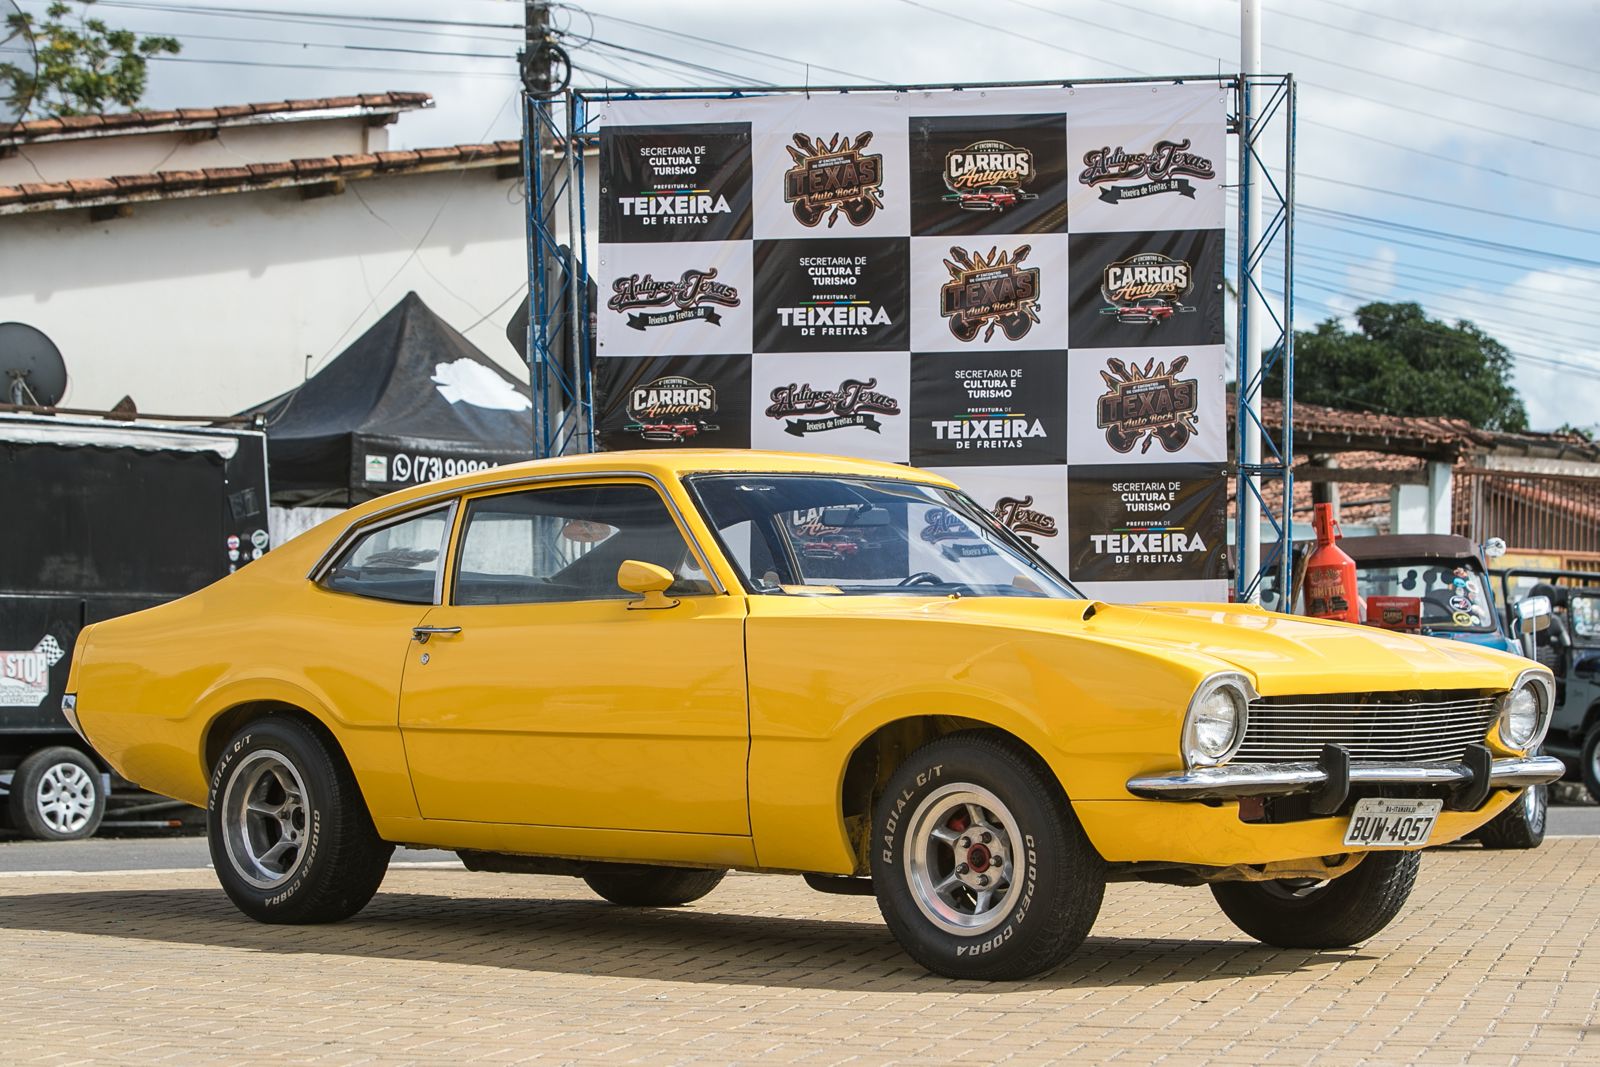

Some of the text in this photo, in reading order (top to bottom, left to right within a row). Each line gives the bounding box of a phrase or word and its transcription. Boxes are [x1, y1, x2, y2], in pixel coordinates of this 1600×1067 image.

[641, 146, 705, 156] SECRETARIA DE
[649, 156, 700, 165] CULTURA E
[950, 152, 1029, 177] CARROS
[1079, 146, 1146, 183] Antigos
[1148, 138, 1213, 180] Texas
[653, 166, 696, 175] TURISMO
[791, 160, 874, 194] TEXAS
[954, 167, 1018, 187] Antigos
[810, 186, 859, 201] Auto Rock
[1120, 189, 1140, 198] Teixeira
[1141, 187, 1148, 195] de
[1149, 183, 1167, 193] Freitas
[664, 216, 708, 224] FREITAS
[800, 257, 866, 266] SECRETARIA DE
[808, 267, 852, 275] CULTURA
[1108, 265, 1187, 290] CARROS
[608, 274, 675, 308] Antigos
[677, 268, 738, 307] Texas
[812, 277, 856, 285] TURISMO
[948, 273, 1031, 309] TEXAS
[1112, 280, 1175, 300] Antigos
[966, 301, 1016, 316] Auto Rock
[648, 315, 667, 324] Teixeira
[668, 314, 675, 322] de
[676, 310, 694, 321] Freitas
[822, 327, 867, 335] FREITAS
[955, 369, 1022, 379] SECRETARIA DE
[964, 380, 1007, 388] CULTURA
[633, 389, 711, 411] CARROS
[765, 383, 832, 416] Antigos
[834, 377, 898, 415] Texas
[968, 390, 1012, 398] TURISMO
[636, 401, 700, 418] Antigos
[1106, 384, 1190, 421] TEXAS
[806, 422, 826, 431] Teixeira
[826, 420, 833, 428] de
[834, 417, 853, 427] Freitas
[1123, 411, 1173, 428] Auto Rock
[977, 440, 1022, 448] FREITAS
[1112, 482, 1180, 491] SECRETARIA DE
[1121, 492, 1175, 501] CULTURA E
[995, 495, 1056, 531] Texas
[1126, 503, 1170, 511] TURISMO
[1137, 555, 1182, 563] FREITAS
[6, 653, 47, 684] STOP
[209, 734, 251, 811] RADIAL G/T
[883, 764, 943, 864] RADIAL G/T
[264, 809, 321, 907] COOPER COBRA
[956, 834, 1037, 956] COOPER COBRA
